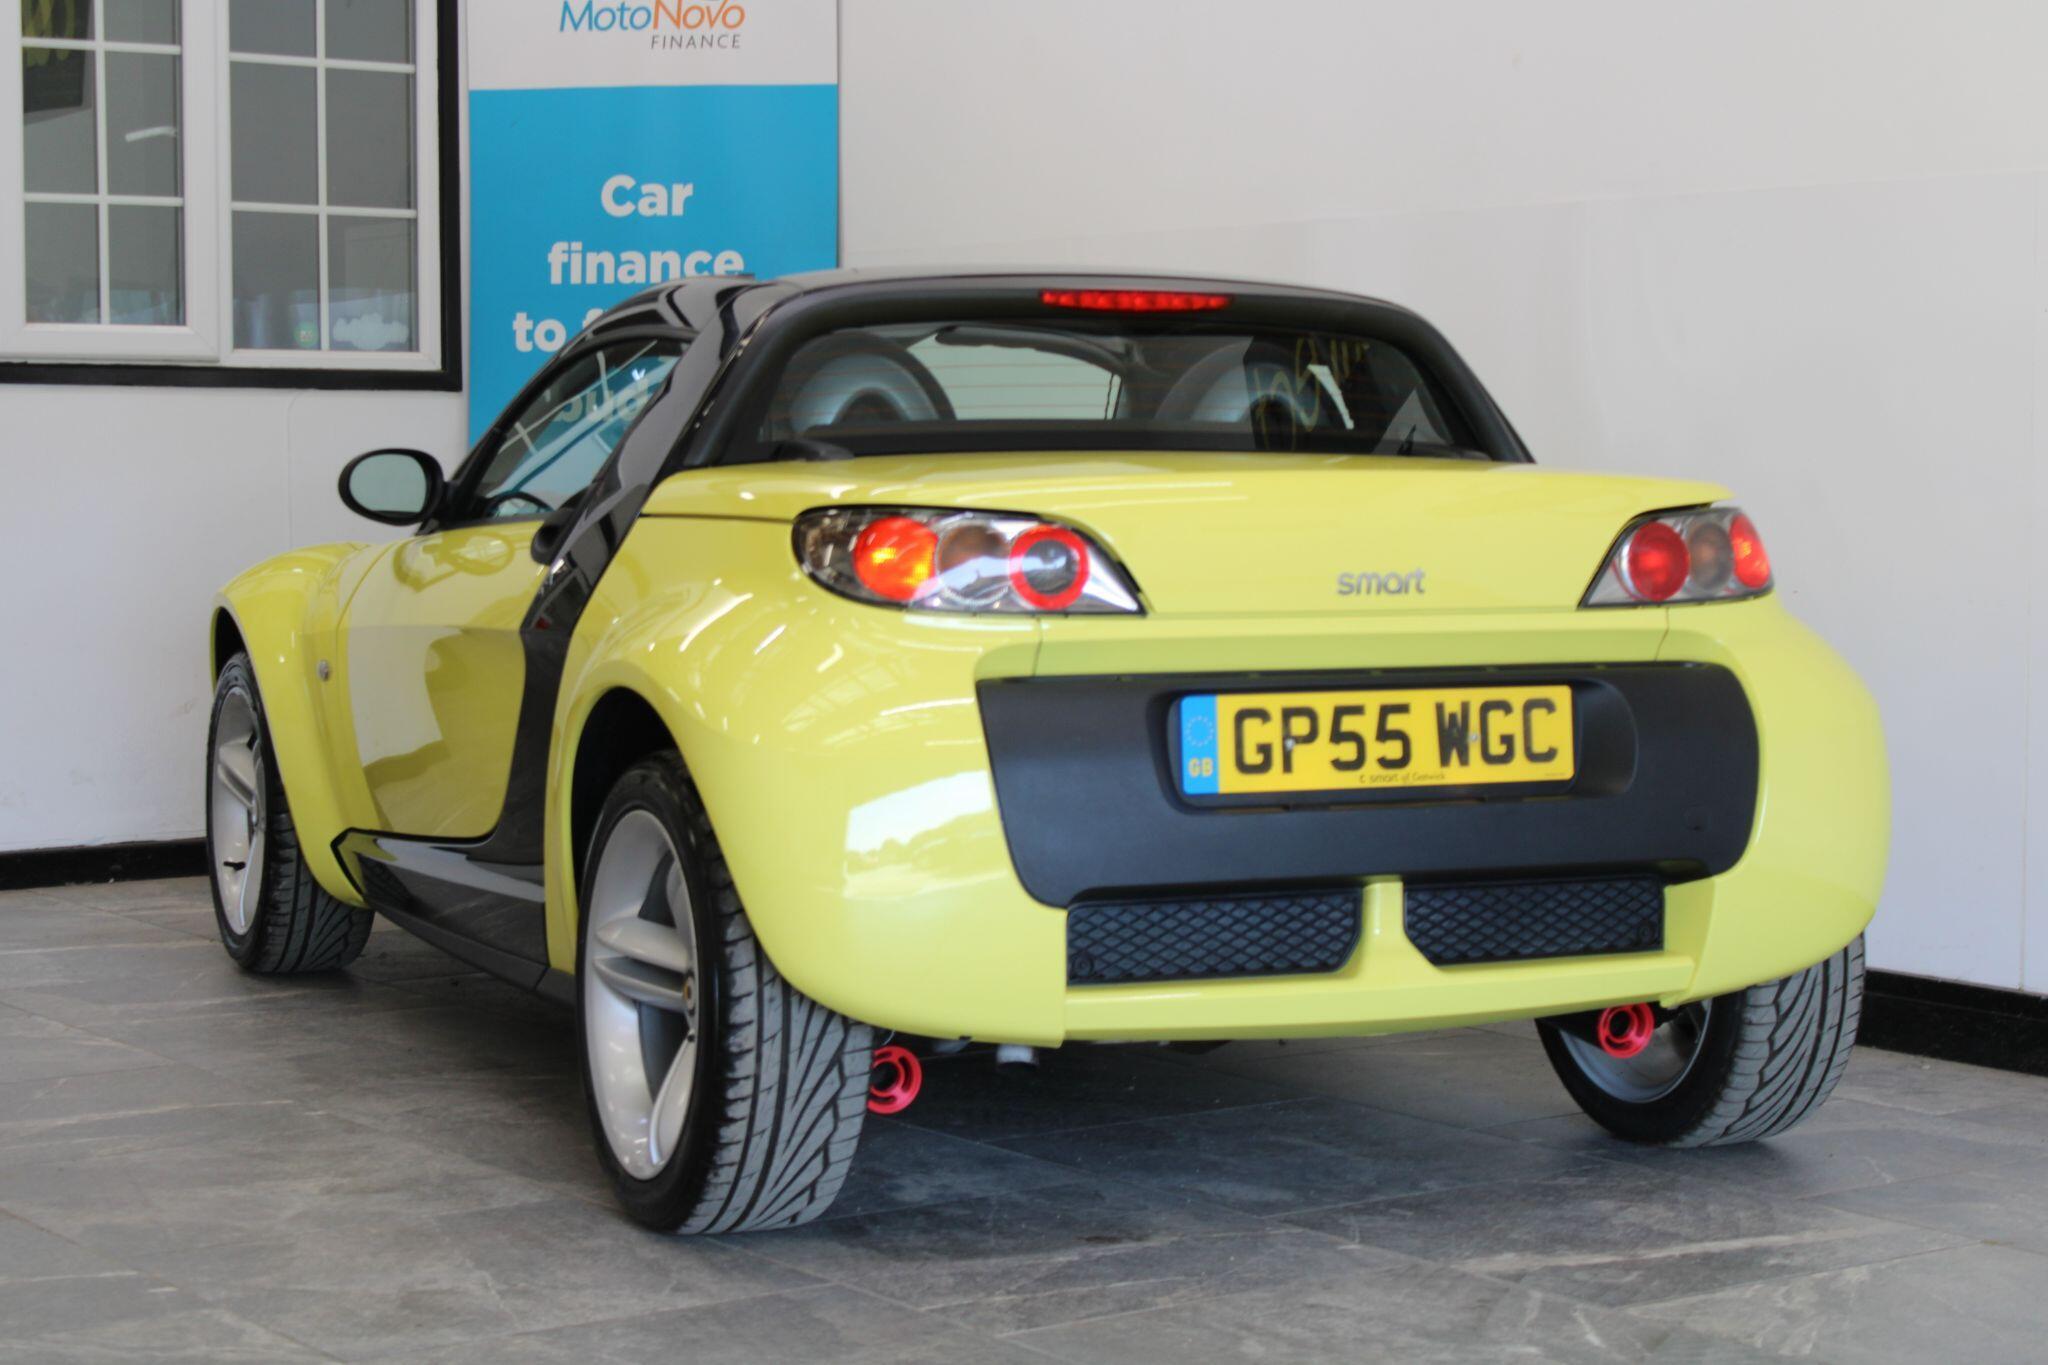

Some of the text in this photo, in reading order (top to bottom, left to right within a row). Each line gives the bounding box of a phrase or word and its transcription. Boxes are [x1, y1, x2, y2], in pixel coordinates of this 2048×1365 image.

[559, 0, 746, 32] MotoNovo
[651, 34, 741, 49] FINANCE
[601, 174, 693, 217] Car
[548, 241, 744, 285] finance
[513, 313, 566, 352] to
[1337, 567, 1425, 595] smart
[1234, 698, 1558, 774] GP55 WGC
[1187, 757, 1213, 777] GB
